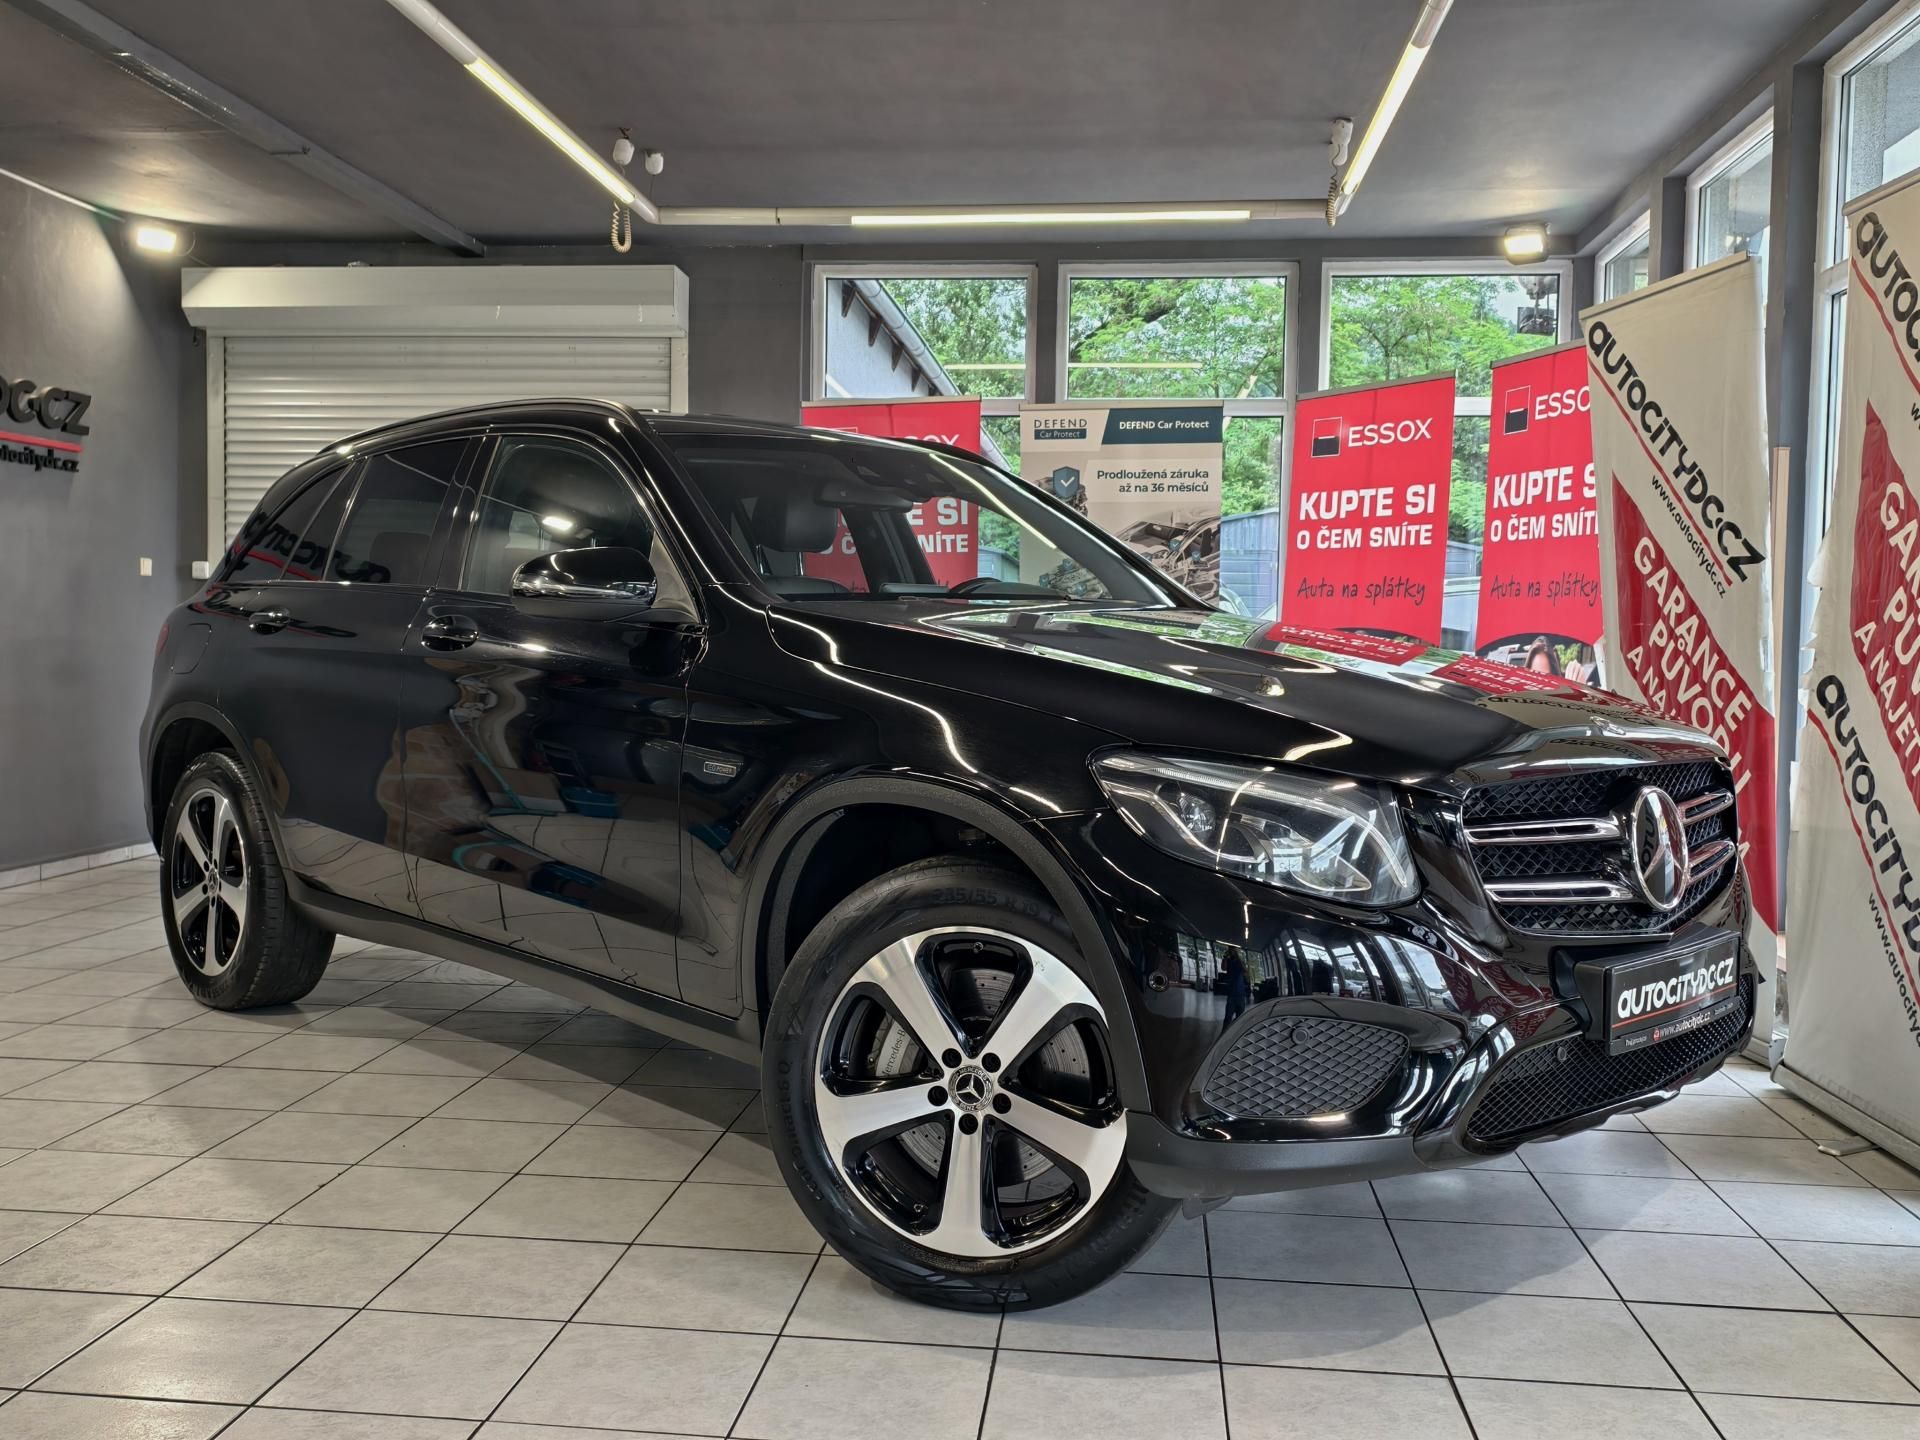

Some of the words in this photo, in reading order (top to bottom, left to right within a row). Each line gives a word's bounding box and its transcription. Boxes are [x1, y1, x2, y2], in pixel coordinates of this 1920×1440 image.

[1535, 386, 1590, 421] ESSO
[1034, 419, 1088, 428] DEFEND
[1039, 430, 1052, 438] Car
[1053, 430, 1080, 438] Protect
[1119, 421, 1155, 430] DEFEND
[1157, 420, 1173, 429] Car
[1175, 420, 1210, 429] Protect
[1348, 418, 1432, 447] ESSOX
[1097, 468, 1167, 480] Prodloužená
[1170, 468, 1209, 479] záruka
[1119, 483, 1132, 494] až
[1134, 484, 1149, 493] na
[1151, 484, 1165, 493] 36
[1167, 481, 1209, 493] měsíců
[1493, 466, 1573, 508] KUPTE
[1583, 462, 1597, 498] S
[1299, 486, 1394, 521] KUPTE
[1405, 484, 1436, 515] SI
[918, 531, 969, 553] NÍTE
[1296, 530, 1310, 550] O
[1316, 525, 1362, 550] ČEM
[1369, 521, 1433, 548] SNÍTE
[1490, 520, 1502, 542] O
[1507, 513, 1545, 541] ČEM
[1651, 475, 1726, 598] www.autocitydc.cz
[1297, 577, 1335, 598] Auta
[1341, 583, 1358, 598] na
[1365, 575, 1425, 606] splátky
[1490, 575, 1521, 599] Auta
[1527, 582, 1541, 597] na
[1546, 575, 1598, 607] splátky
[1633, 536, 1752, 732] GARANCE
[1854, 621, 1877, 654] A
